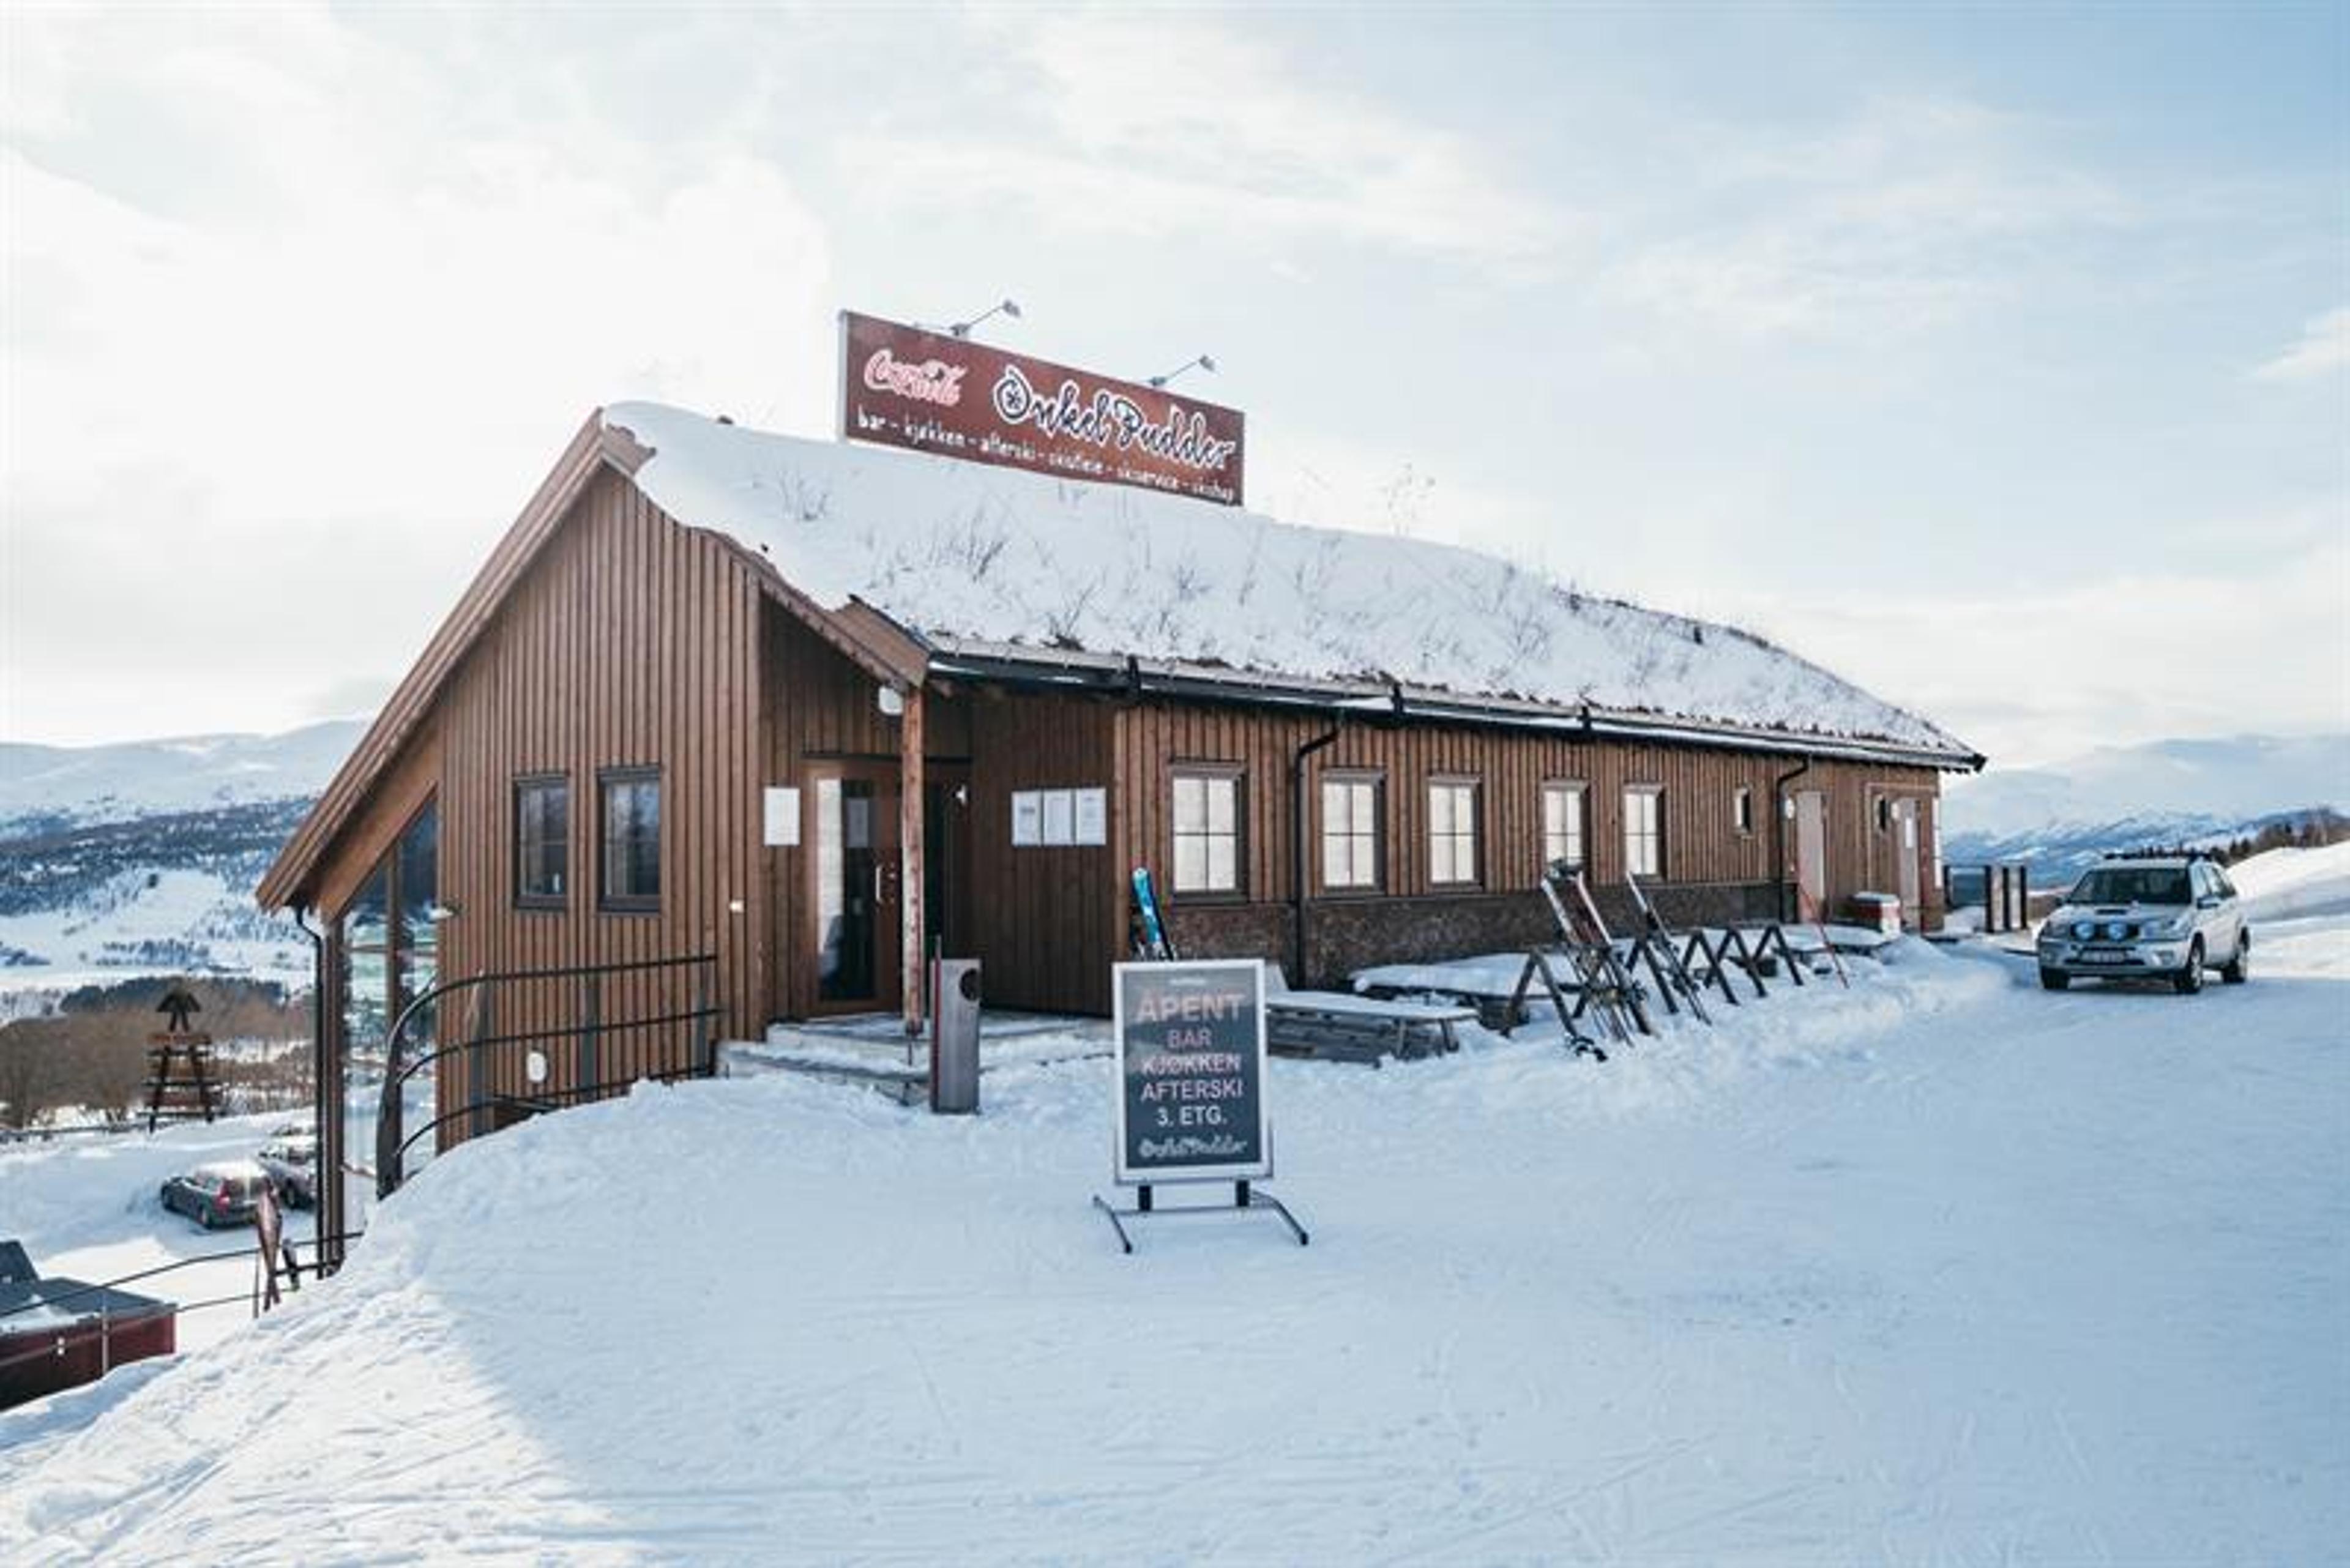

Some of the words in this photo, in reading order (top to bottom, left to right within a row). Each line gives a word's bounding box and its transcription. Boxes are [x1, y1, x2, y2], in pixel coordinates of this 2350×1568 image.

[858, 404, 886, 430] bar
[993, 365, 1111, 449] Onkel
[1108, 394, 1236, 469] Pudder
[1168, 1026, 1213, 1048] BAR
[1142, 1053, 1241, 1075] KJØKKEN
[1141, 1080, 1244, 1102] AFTERSKI
[1157, 1107, 1174, 1128] 3.
[1180, 1105, 1228, 1126] ETG.
